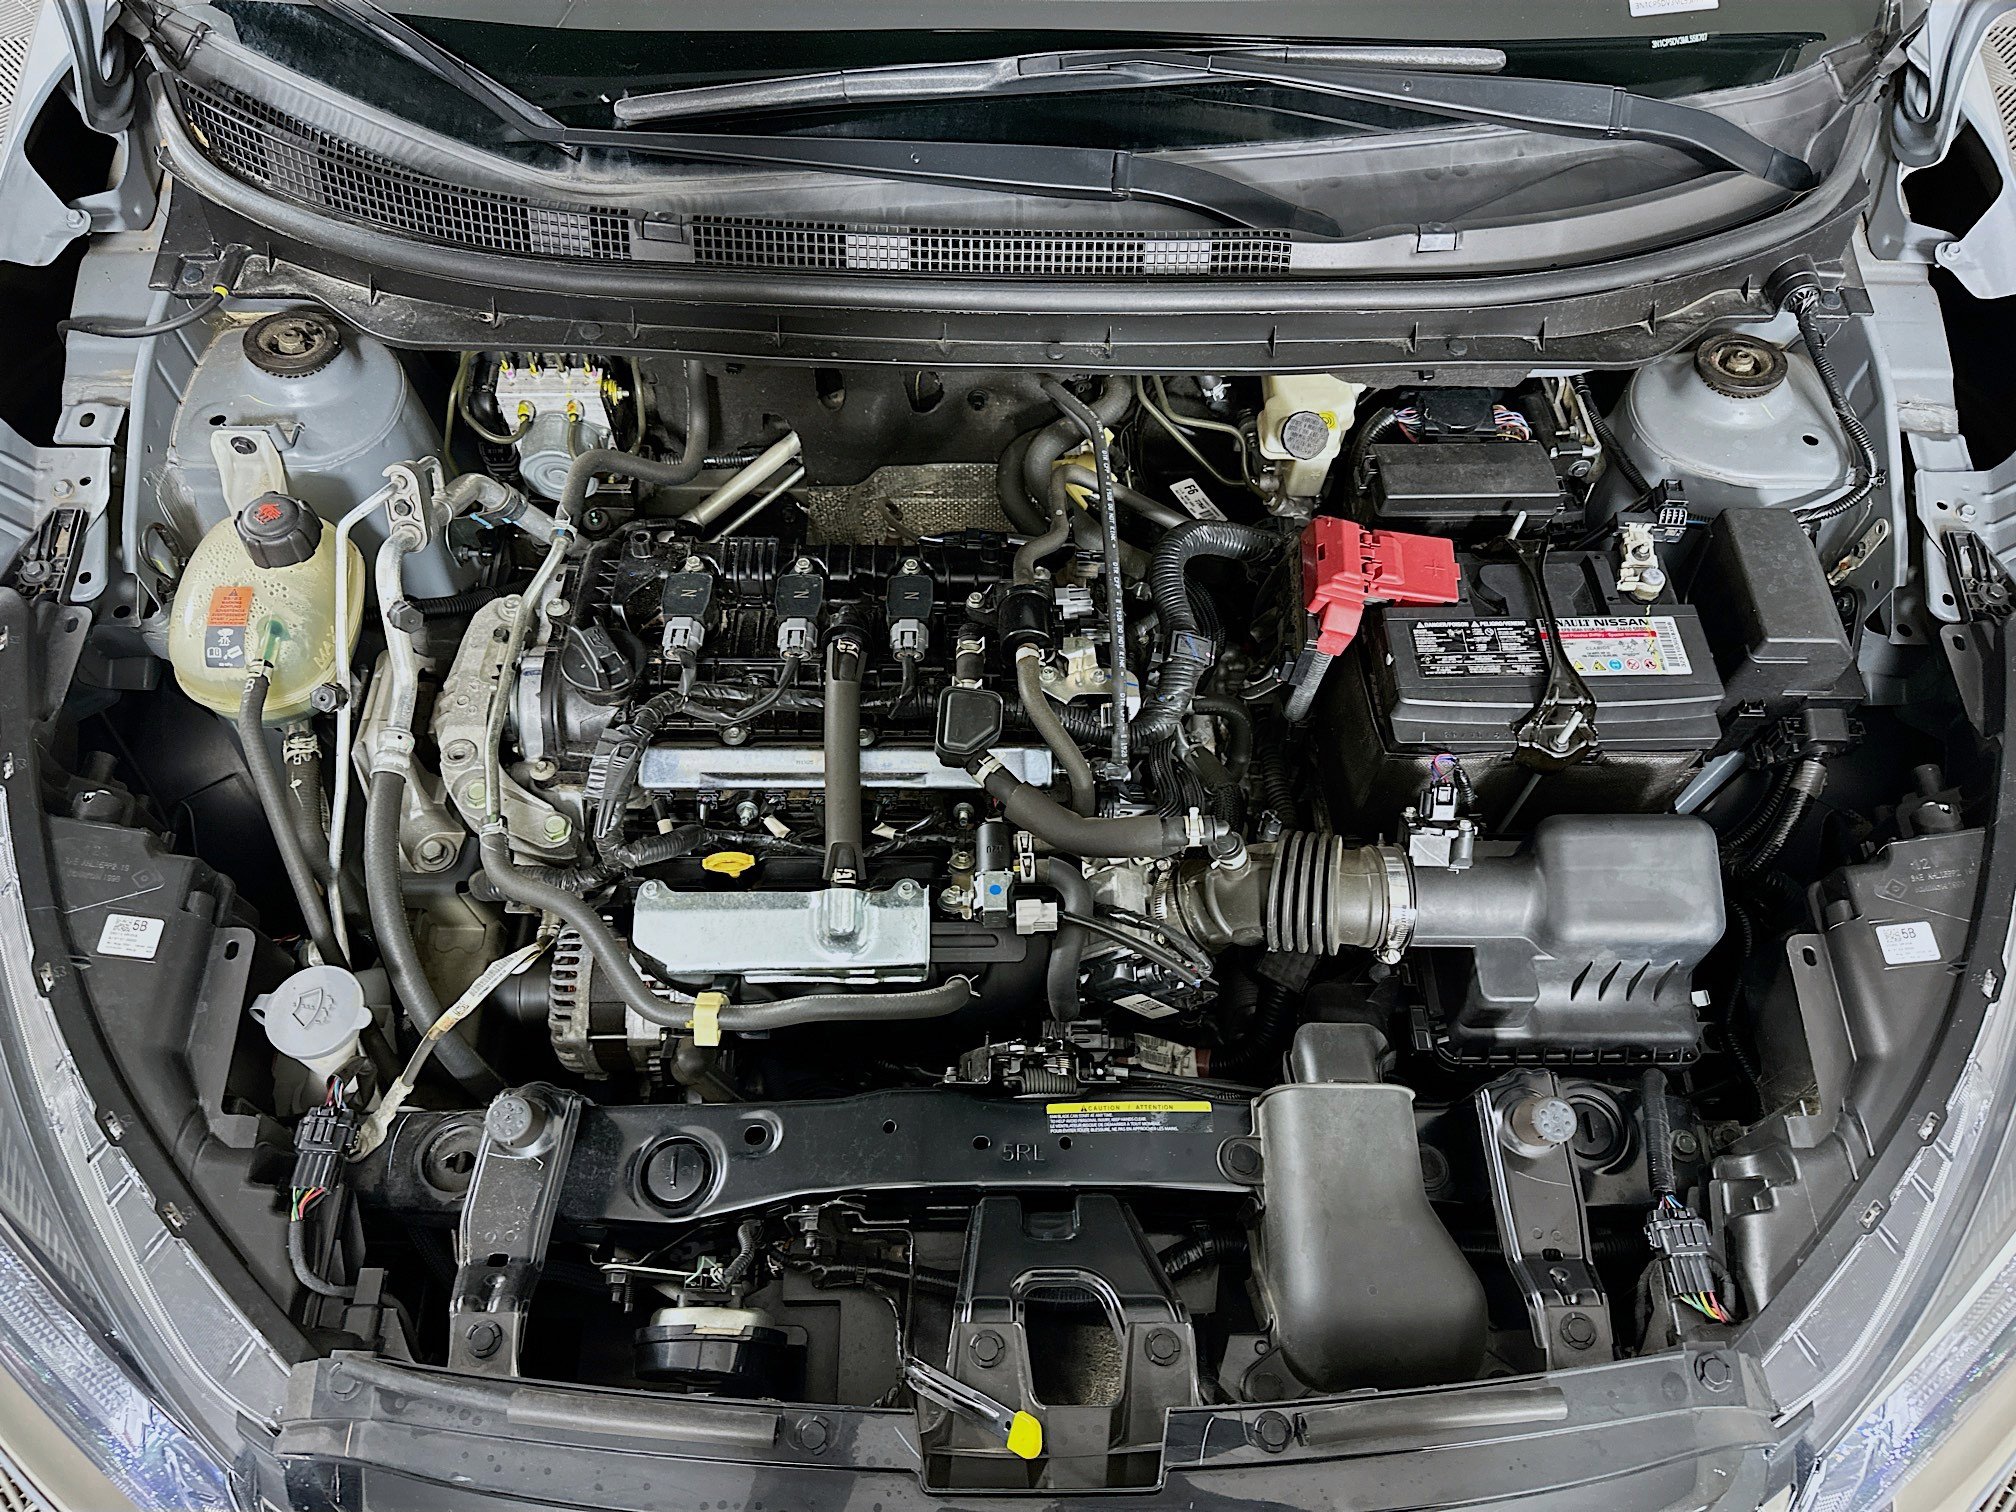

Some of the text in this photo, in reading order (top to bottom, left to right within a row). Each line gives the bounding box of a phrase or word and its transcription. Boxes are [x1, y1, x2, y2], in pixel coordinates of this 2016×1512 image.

[1593, 618, 1650, 627] NISSAN
[1117, 635, 1125, 648] NOT
[1118, 651, 1126, 668] KINK
[1001, 1142, 1046, 1163] 5RL
